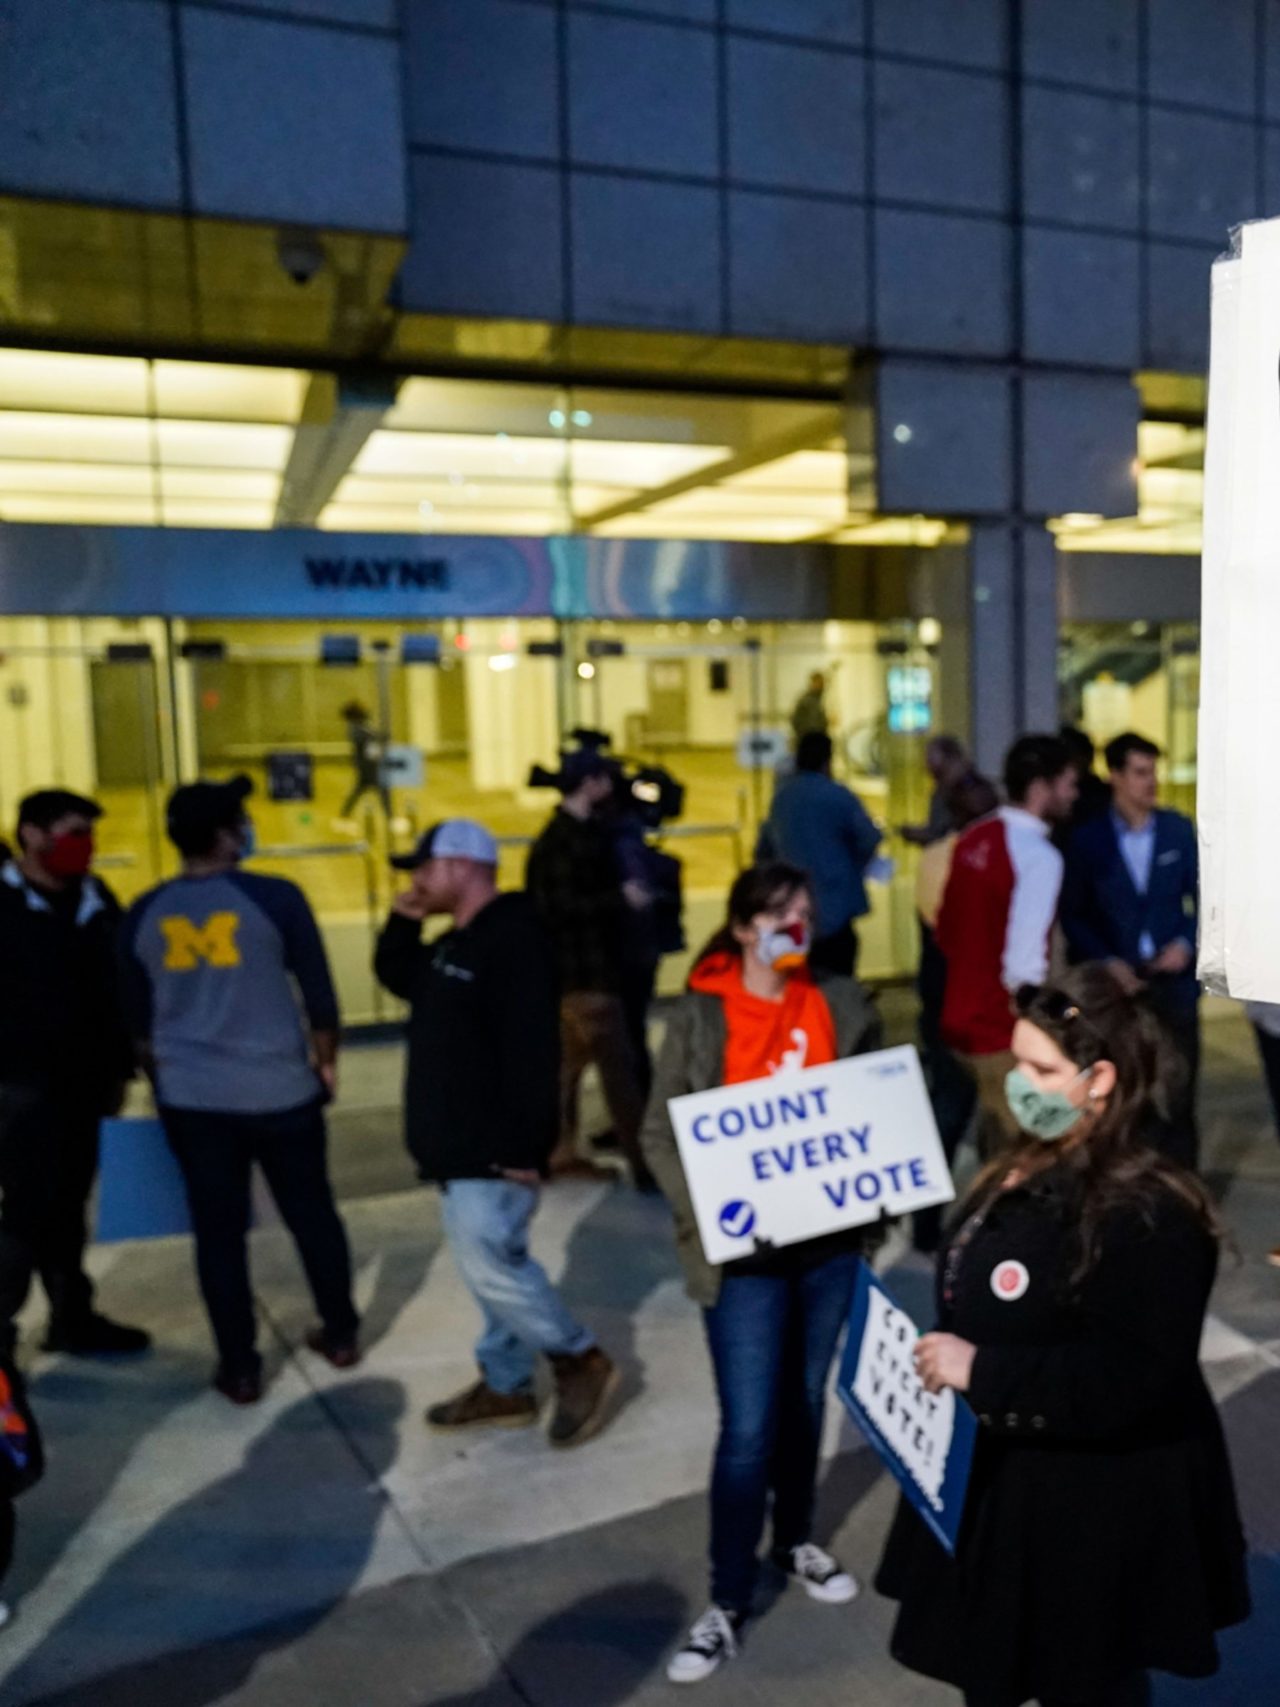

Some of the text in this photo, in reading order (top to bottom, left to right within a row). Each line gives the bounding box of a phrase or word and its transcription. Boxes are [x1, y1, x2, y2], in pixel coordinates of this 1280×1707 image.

[304, 557, 450, 591] WAYNE
[160, 910, 241, 971] M
[691, 1086, 829, 1144] COUNT
[751, 1124, 871, 1181] EVERY
[823, 1159, 929, 1210] VOTE
